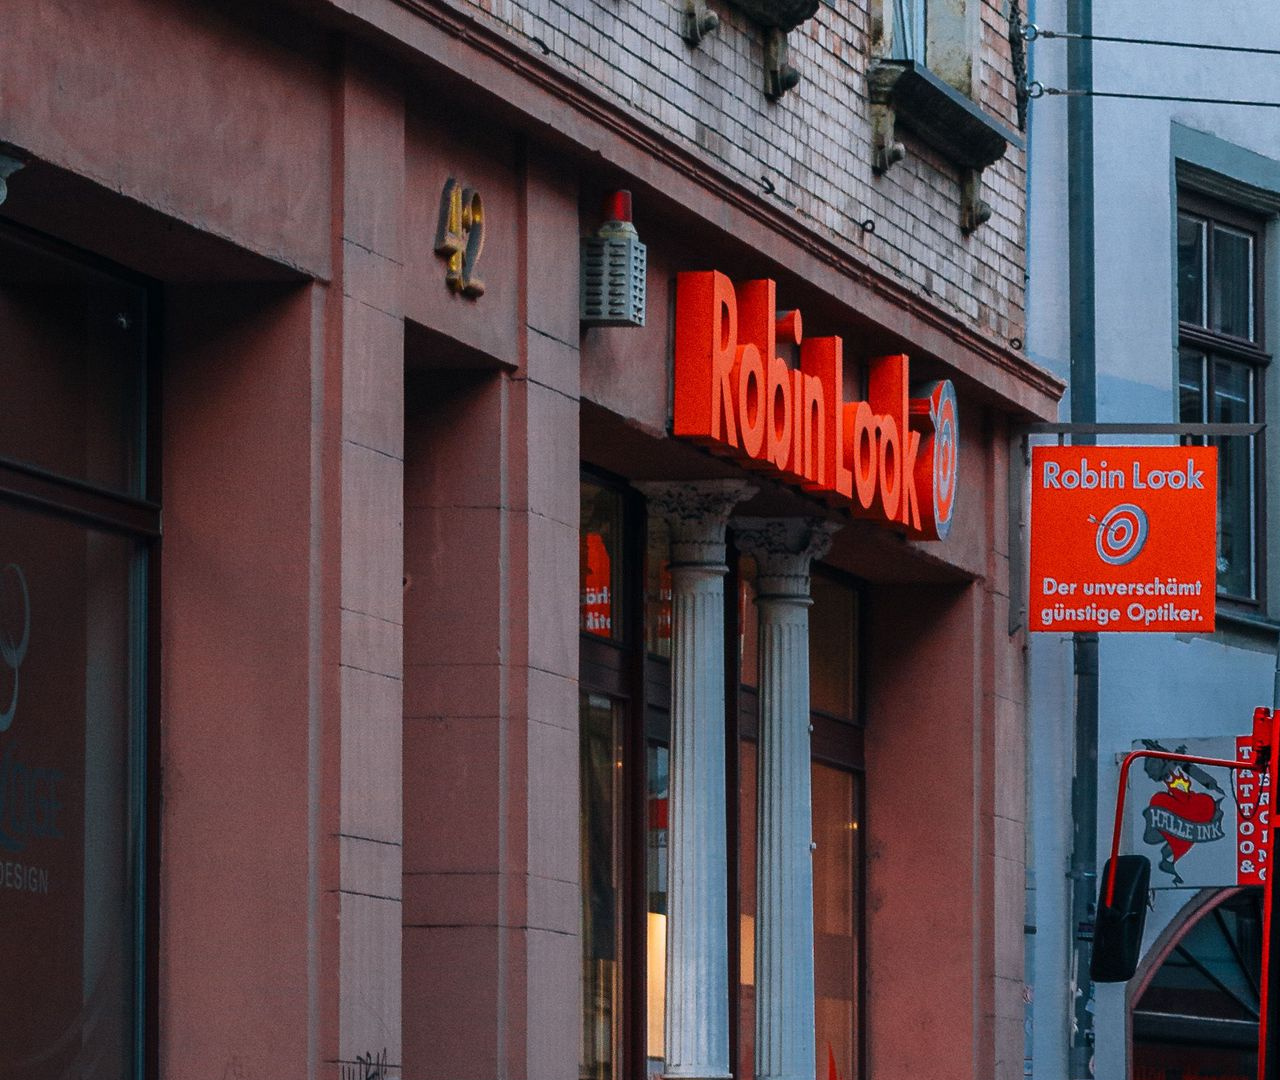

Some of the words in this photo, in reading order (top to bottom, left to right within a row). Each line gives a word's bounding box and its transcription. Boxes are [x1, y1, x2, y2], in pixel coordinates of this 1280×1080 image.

[434, 178, 484, 300] 42
[711, 268, 826, 488] Robin
[834, 334, 922, 532] Look
[1043, 458, 1125, 490] Robin
[1132, 458, 1205, 490] Look
[1043, 577, 1077, 596] Der
[1083, 577, 1202, 596] unverschämt
[1041, 602, 1121, 626] günstige
[1127, 602, 1204, 626] Optiker.
[1150, 808, 1193, 839] HALLE
[1197, 822, 1222, 840] INK
